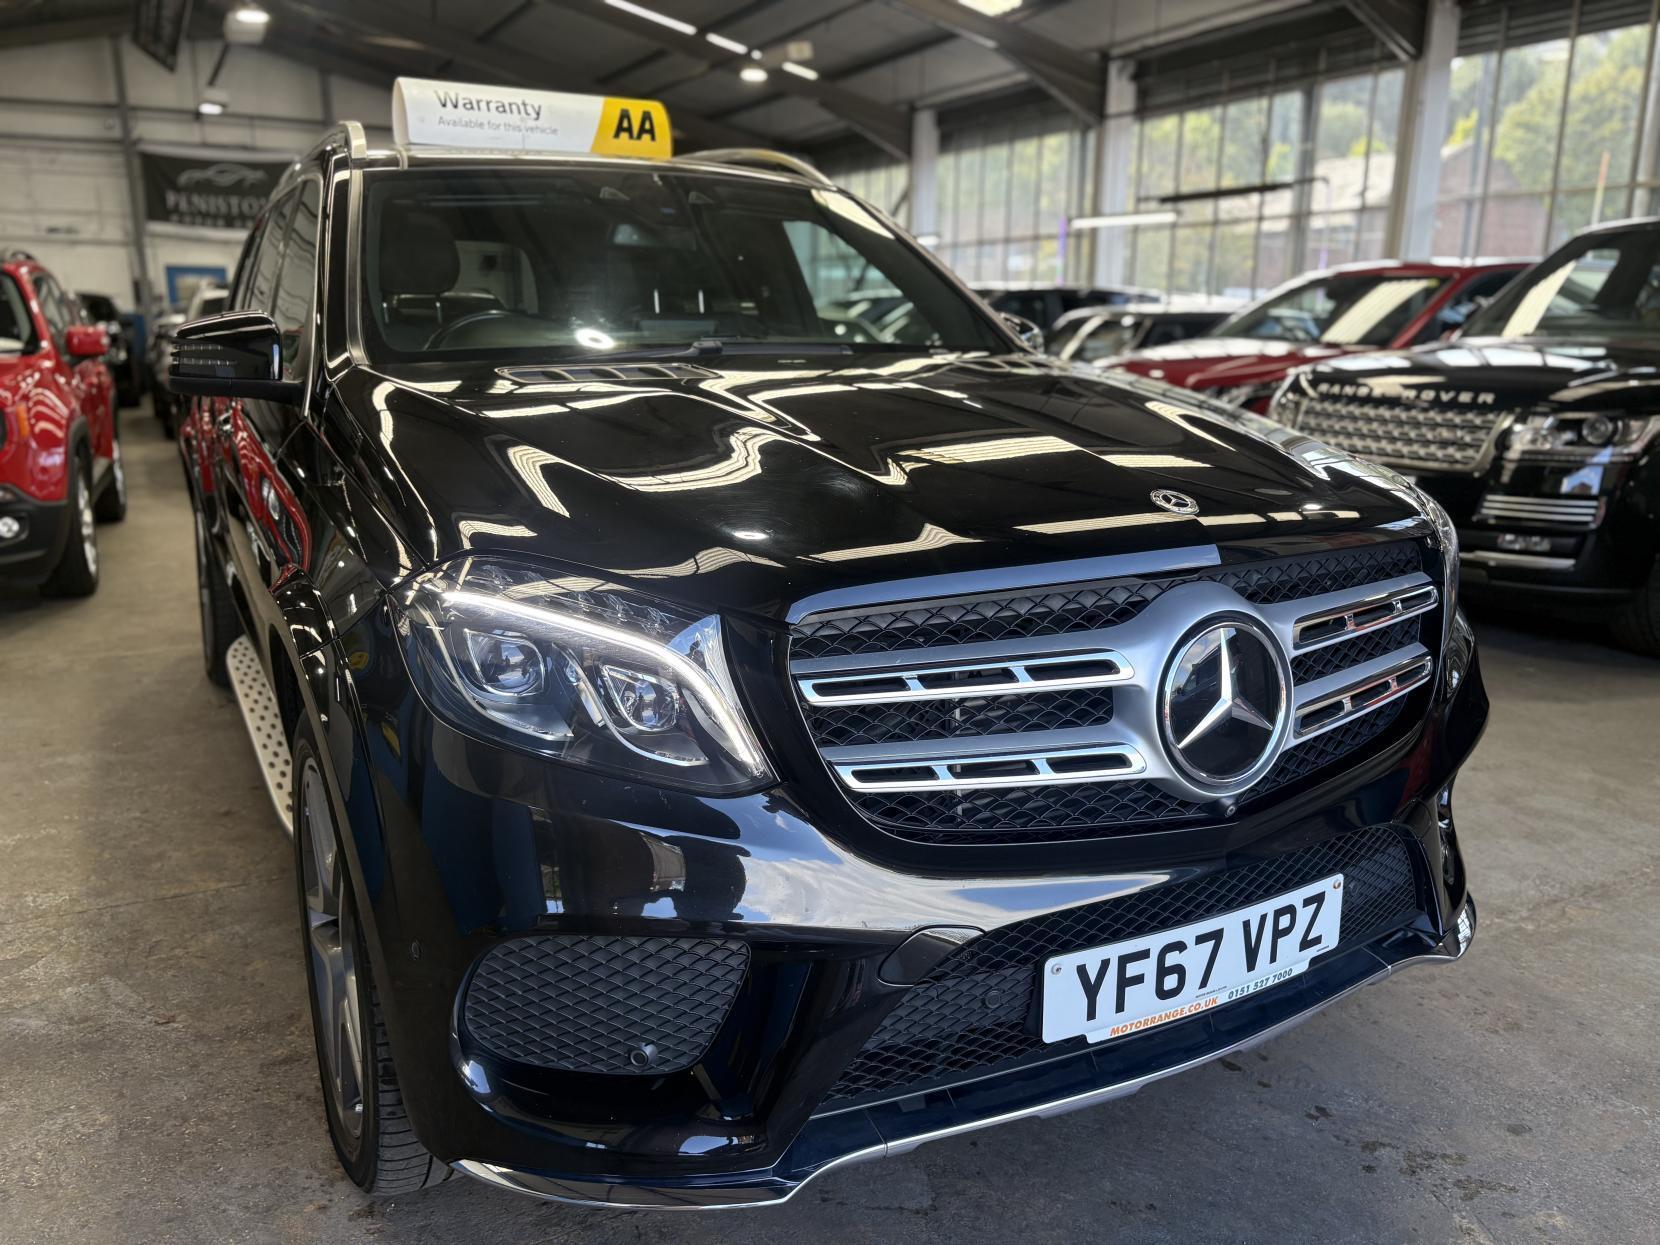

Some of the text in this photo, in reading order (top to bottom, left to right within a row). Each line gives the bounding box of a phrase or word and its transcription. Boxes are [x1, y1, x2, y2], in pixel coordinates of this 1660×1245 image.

[433, 89, 542, 121] Warranty
[438, 116, 559, 136] Available for this vehicle
[613, 108, 656, 142] AA
[1401, 388, 1496, 405] ROVER
[1076, 890, 1326, 1022] YF67 VPZ
[1109, 996, 1219, 1036] MOTORRANGE.CO.UK
[1227, 984, 1250, 1000] 0151
[1252, 977, 1270, 991] 527
[1272, 967, 1293, 983] 7000
